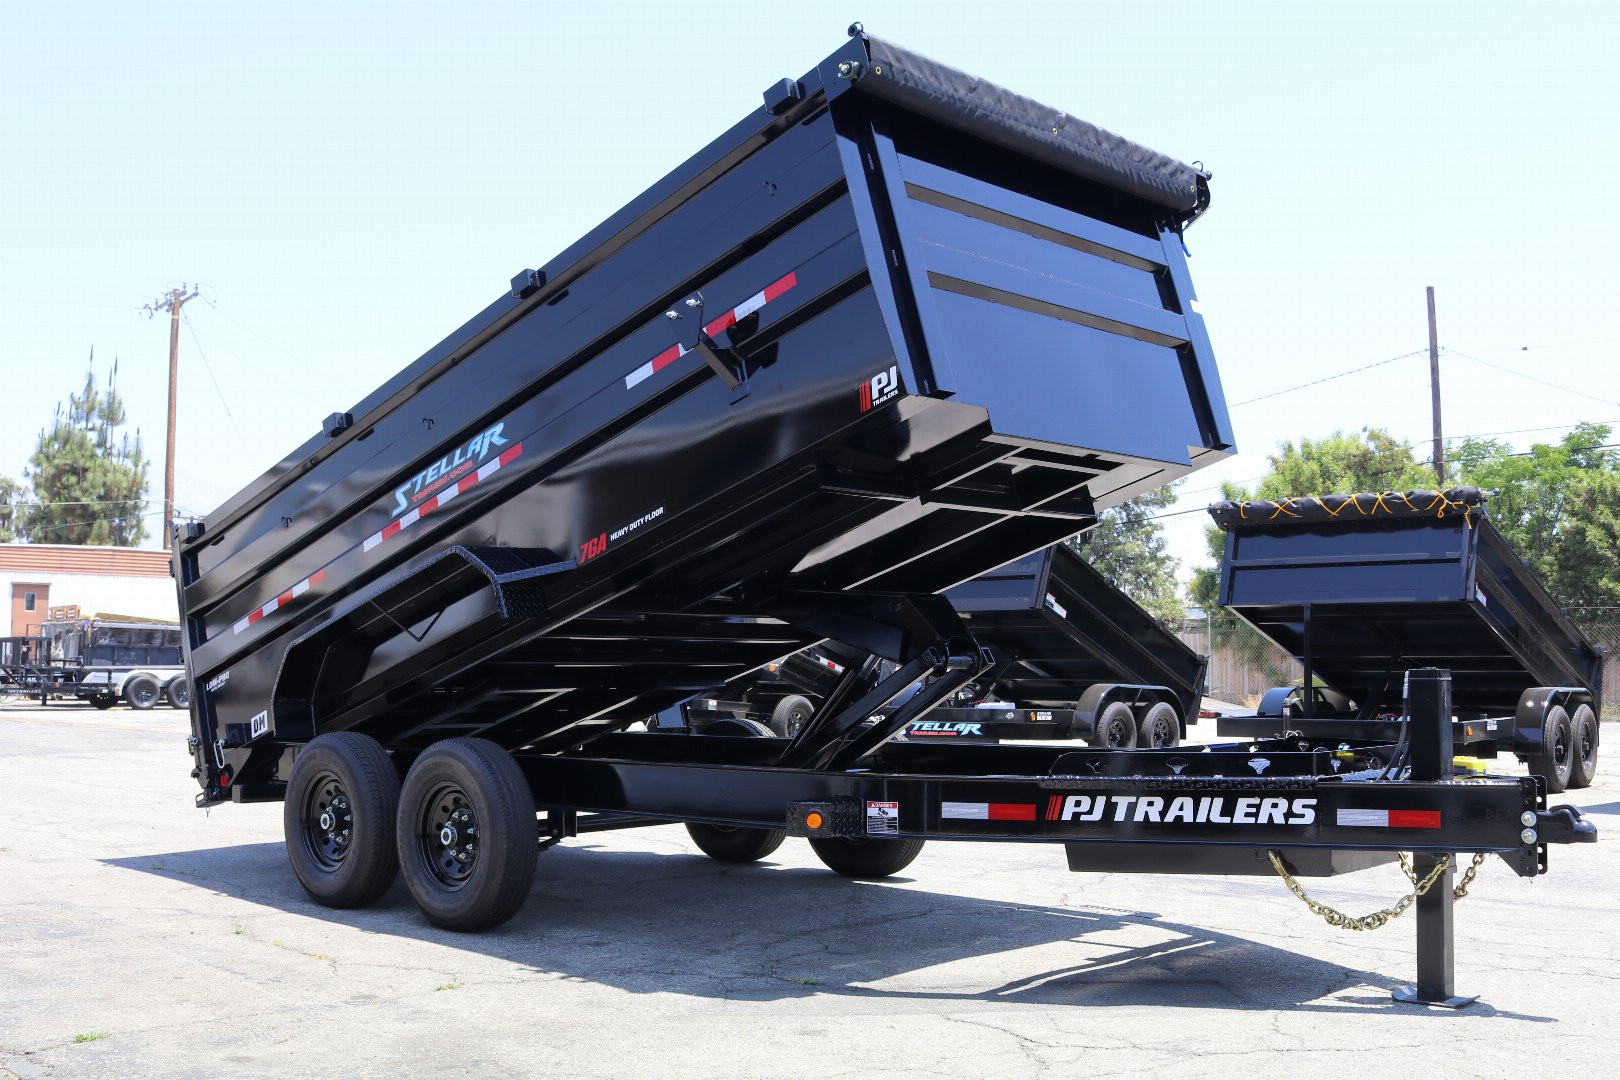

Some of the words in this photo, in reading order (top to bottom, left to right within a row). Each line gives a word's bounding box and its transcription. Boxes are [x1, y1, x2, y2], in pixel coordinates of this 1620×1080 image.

[871, 365, 898, 401] PJ
[872, 389, 899, 407] TRAILERS
[391, 422, 511, 519] STELLAR
[610, 525, 629, 541] HEAVY
[629, 517, 645, 531] DUTY
[645, 506, 664, 523] FLOOR
[900, 722, 983, 736] TELLAR
